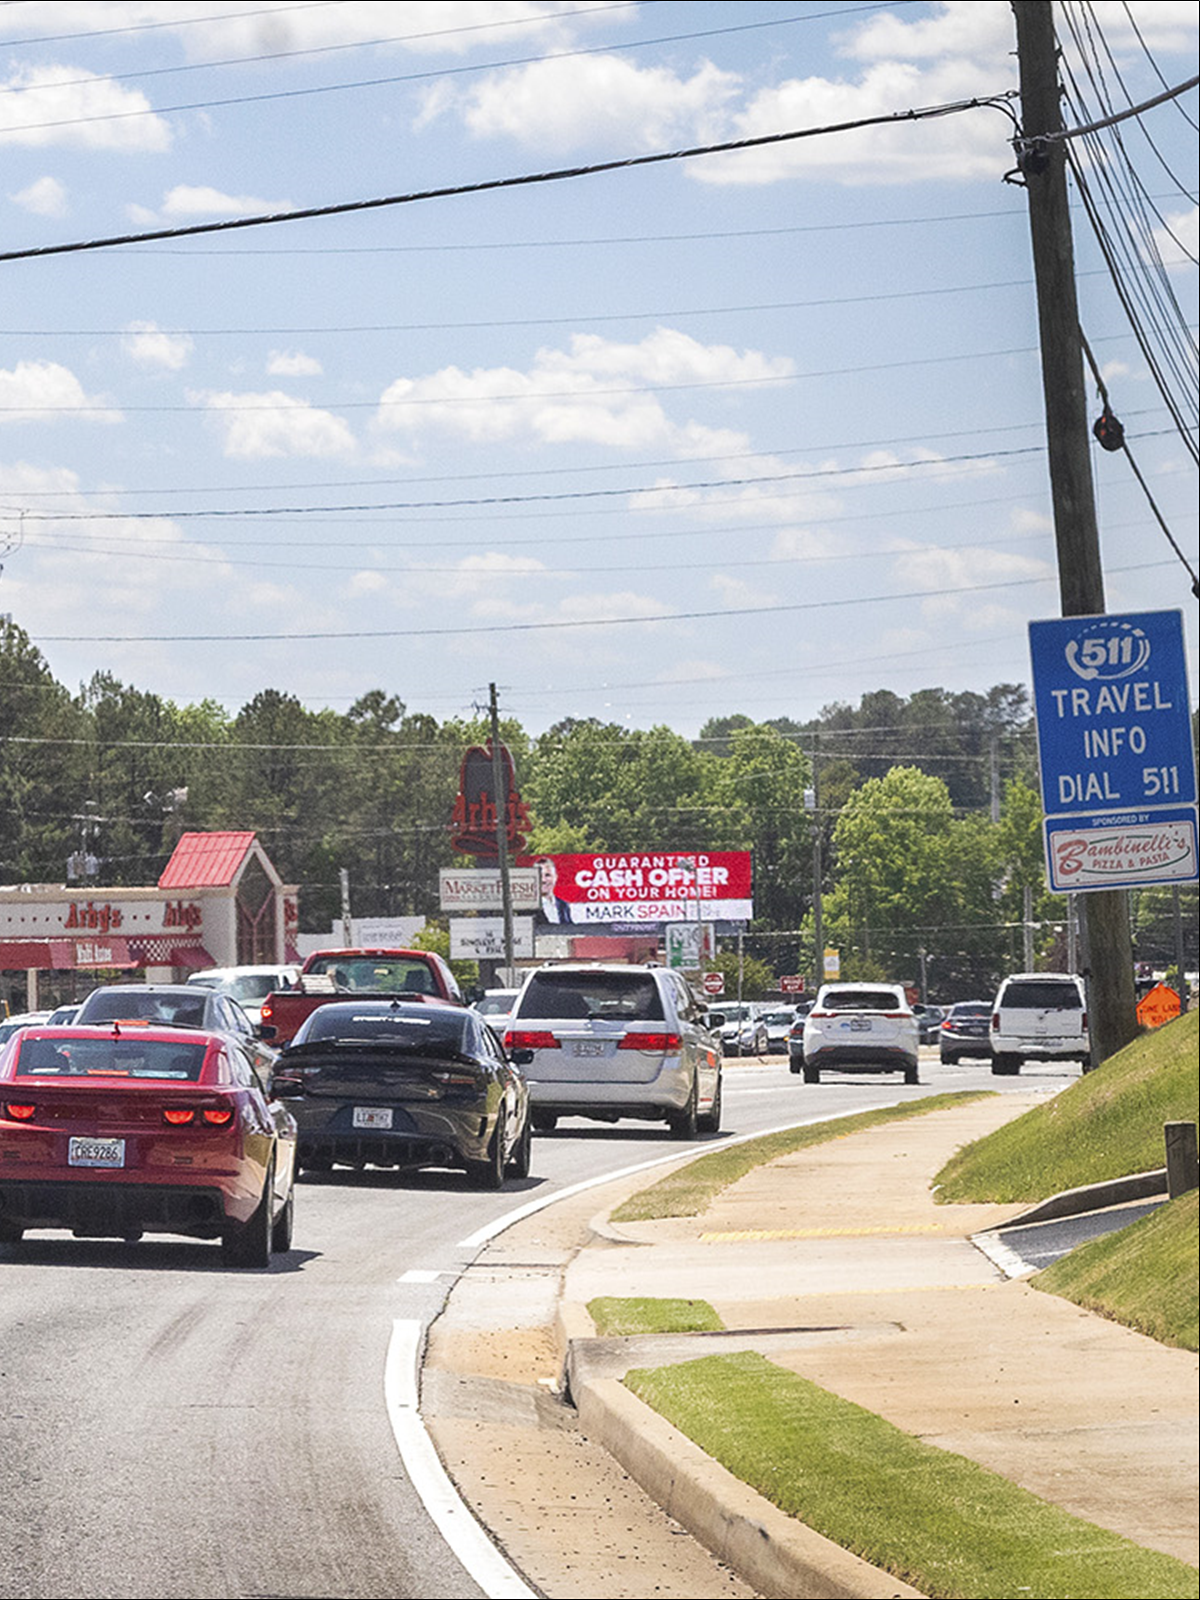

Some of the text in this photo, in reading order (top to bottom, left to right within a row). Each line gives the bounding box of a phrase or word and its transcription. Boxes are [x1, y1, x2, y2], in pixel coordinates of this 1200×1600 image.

[1081, 636, 1133, 666] 511
[1051, 682, 1172, 718] TRAVEL
[1084, 726, 1147, 758] INFO
[1058, 766, 1179, 804] DIAL 511
[1092, 813, 1150, 826] SPONSORED BY
[1057, 833, 1186, 875] Bambinelli's
[1092, 860, 1123, 870] PIZZA
[1140, 852, 1171, 867] PASTA
[575, 867, 729, 888] CASH OFFER
[587, 888, 610, 900] ON
[616, 887, 660, 899] YOUR
[64, 901, 121, 933] Arby's
[586, 905, 635, 919] MARK
[637, 903, 686, 919] SPAIN
